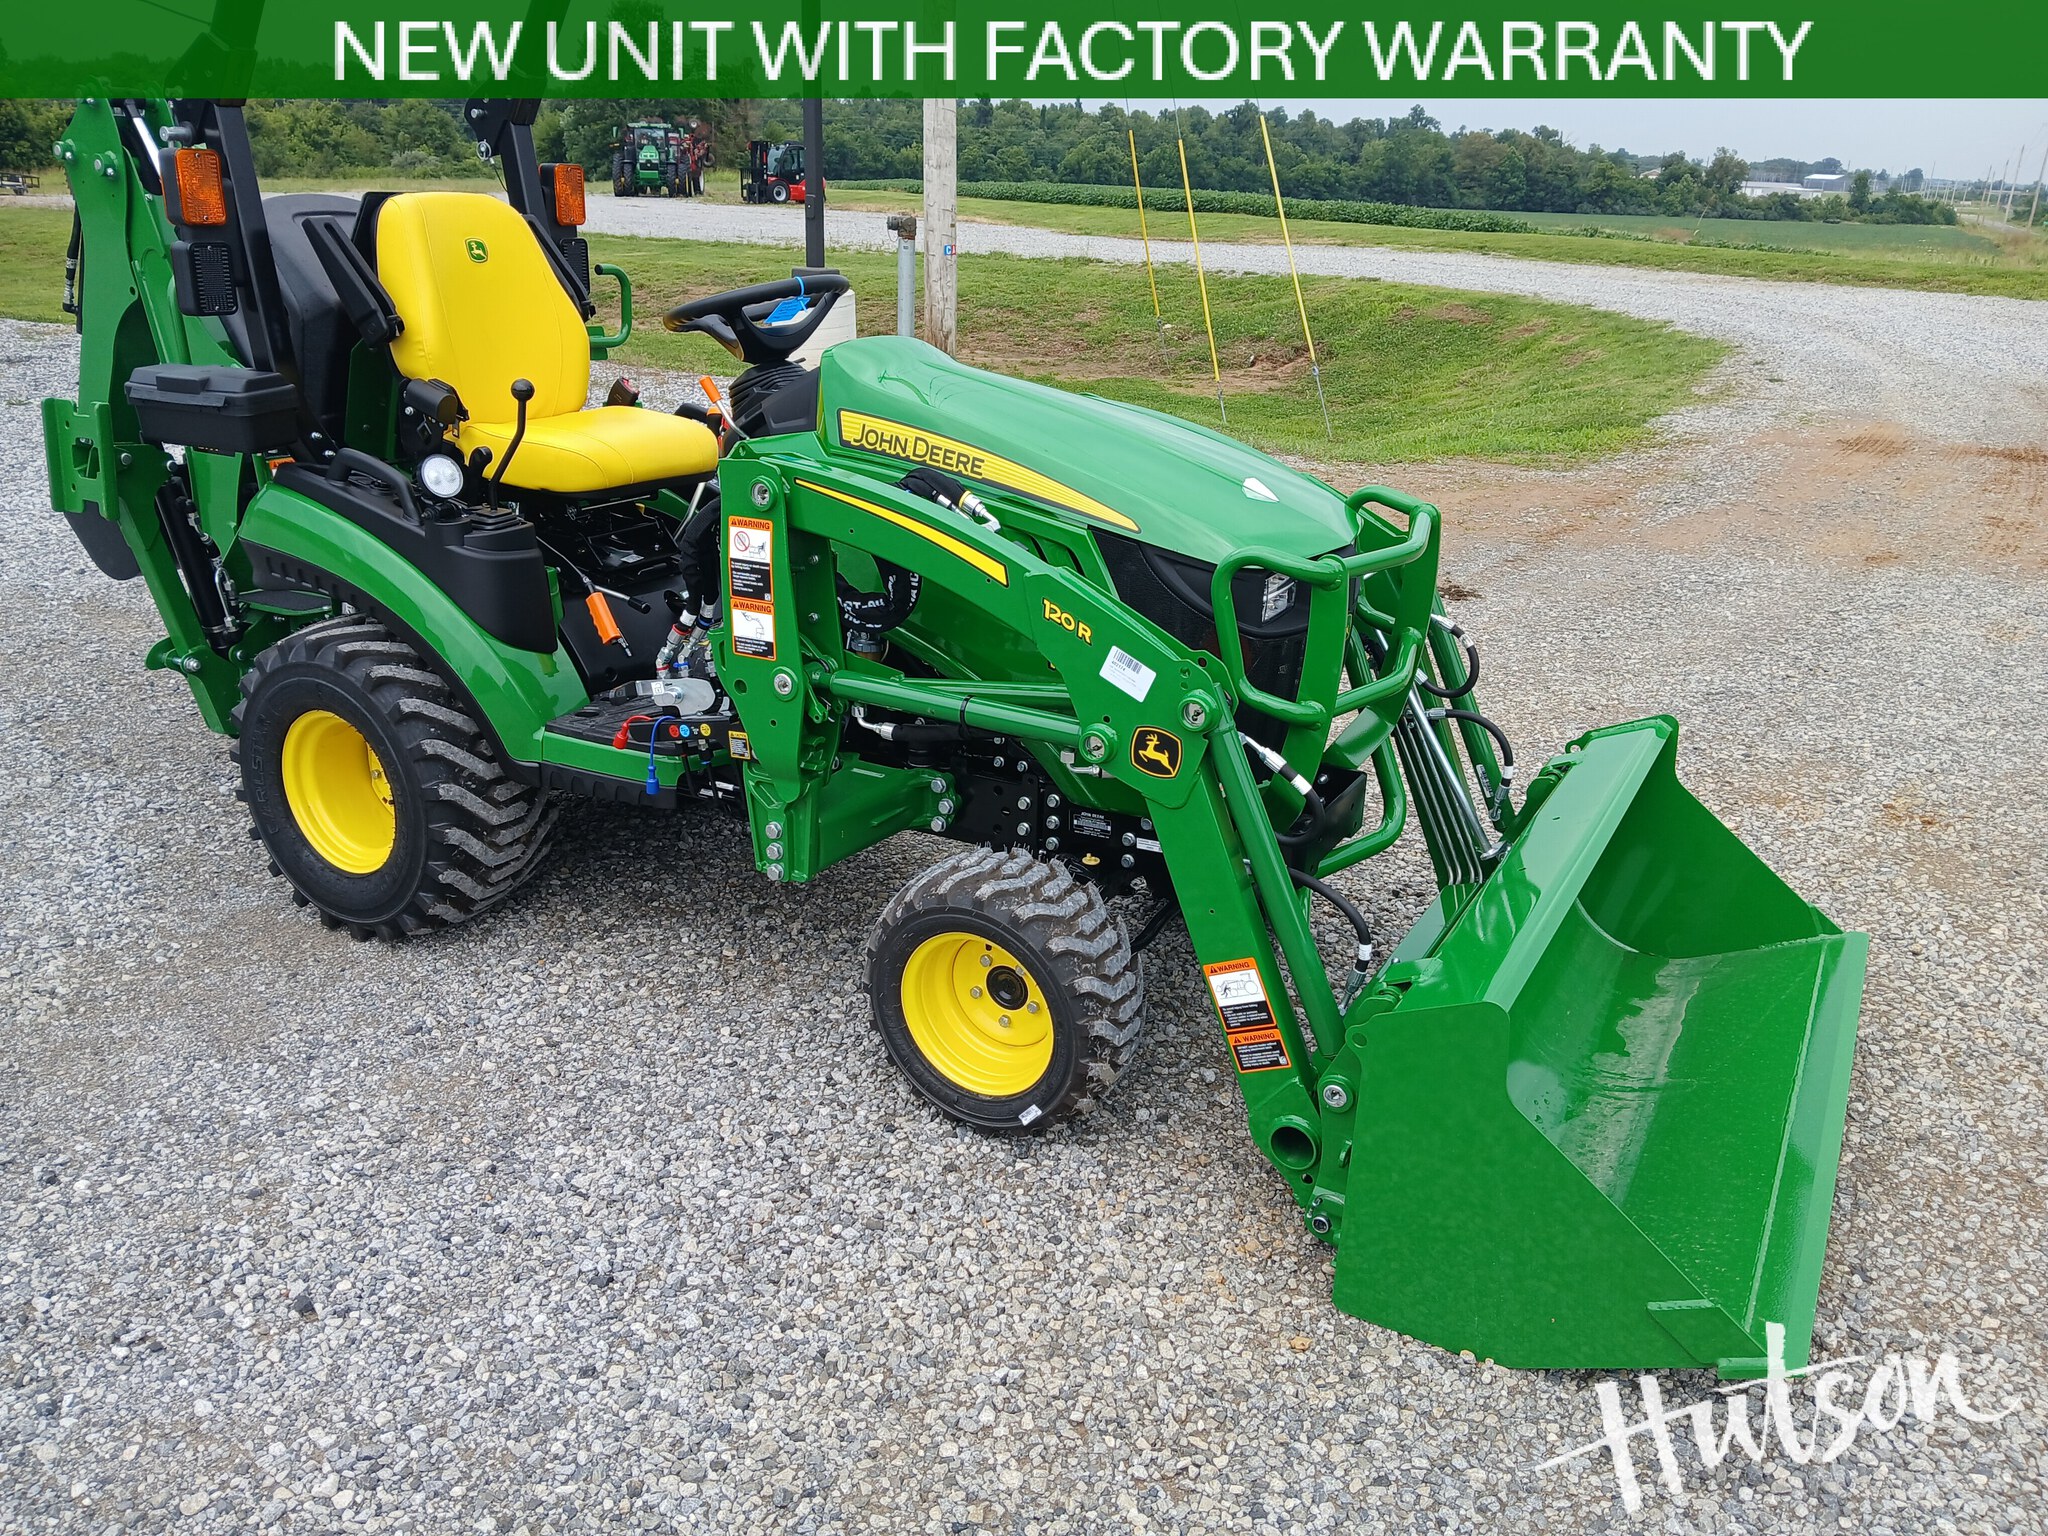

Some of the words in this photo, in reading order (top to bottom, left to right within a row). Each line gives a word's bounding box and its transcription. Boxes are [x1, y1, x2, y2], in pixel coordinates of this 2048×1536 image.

[853, 423, 909, 455] JOHN
[911, 436, 985, 477] DEERE
[736, 518, 770, 530] WARNING
[739, 601, 772, 613] WARNING
[1217, 961, 1250, 973] WARNING
[1242, 1032, 1275, 1043] WARNING
